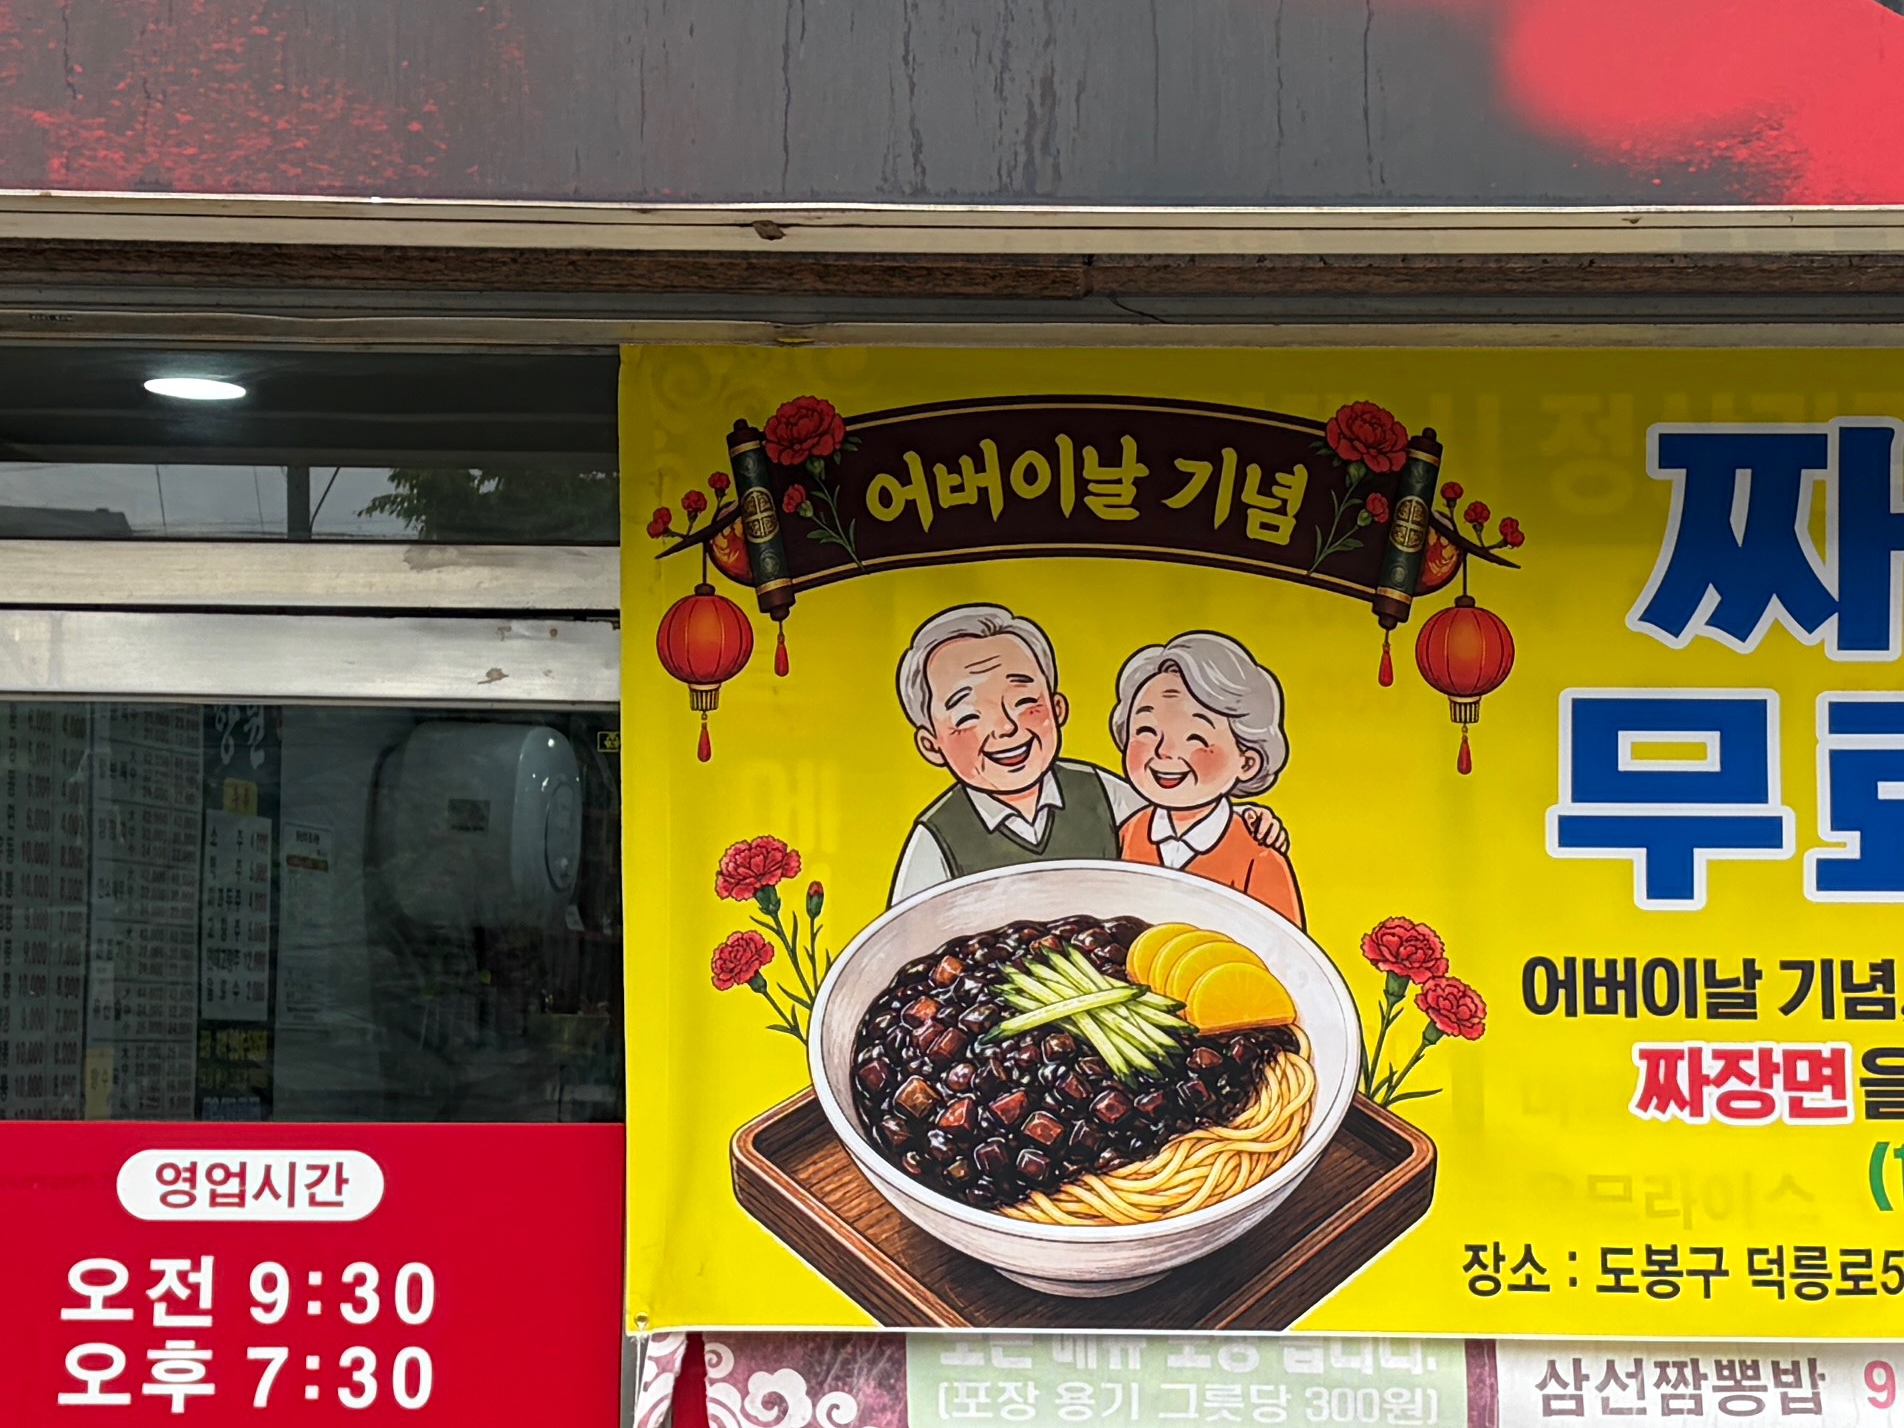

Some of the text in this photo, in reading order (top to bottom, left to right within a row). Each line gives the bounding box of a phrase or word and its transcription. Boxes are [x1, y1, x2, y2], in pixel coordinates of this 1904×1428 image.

[865, 434, 1309, 547] 어버이날 기념
[1522, 956, 1763, 1022] 어버이날
[153, 1159, 350, 1209] 영업시간
[59, 1254, 436, 1328] 오전 9:30
[1461, 1243, 1551, 1295] 장소
[1595, 1243, 1730, 1301] 도봉구
[57, 1339, 434, 1414] 오후 7:30
[1055, 1381, 1140, 1422] 용기
[1159, 1382, 1292, 1426] 그릇당
[1534, 1354, 1826, 1420] 삼선짬뽕밥
